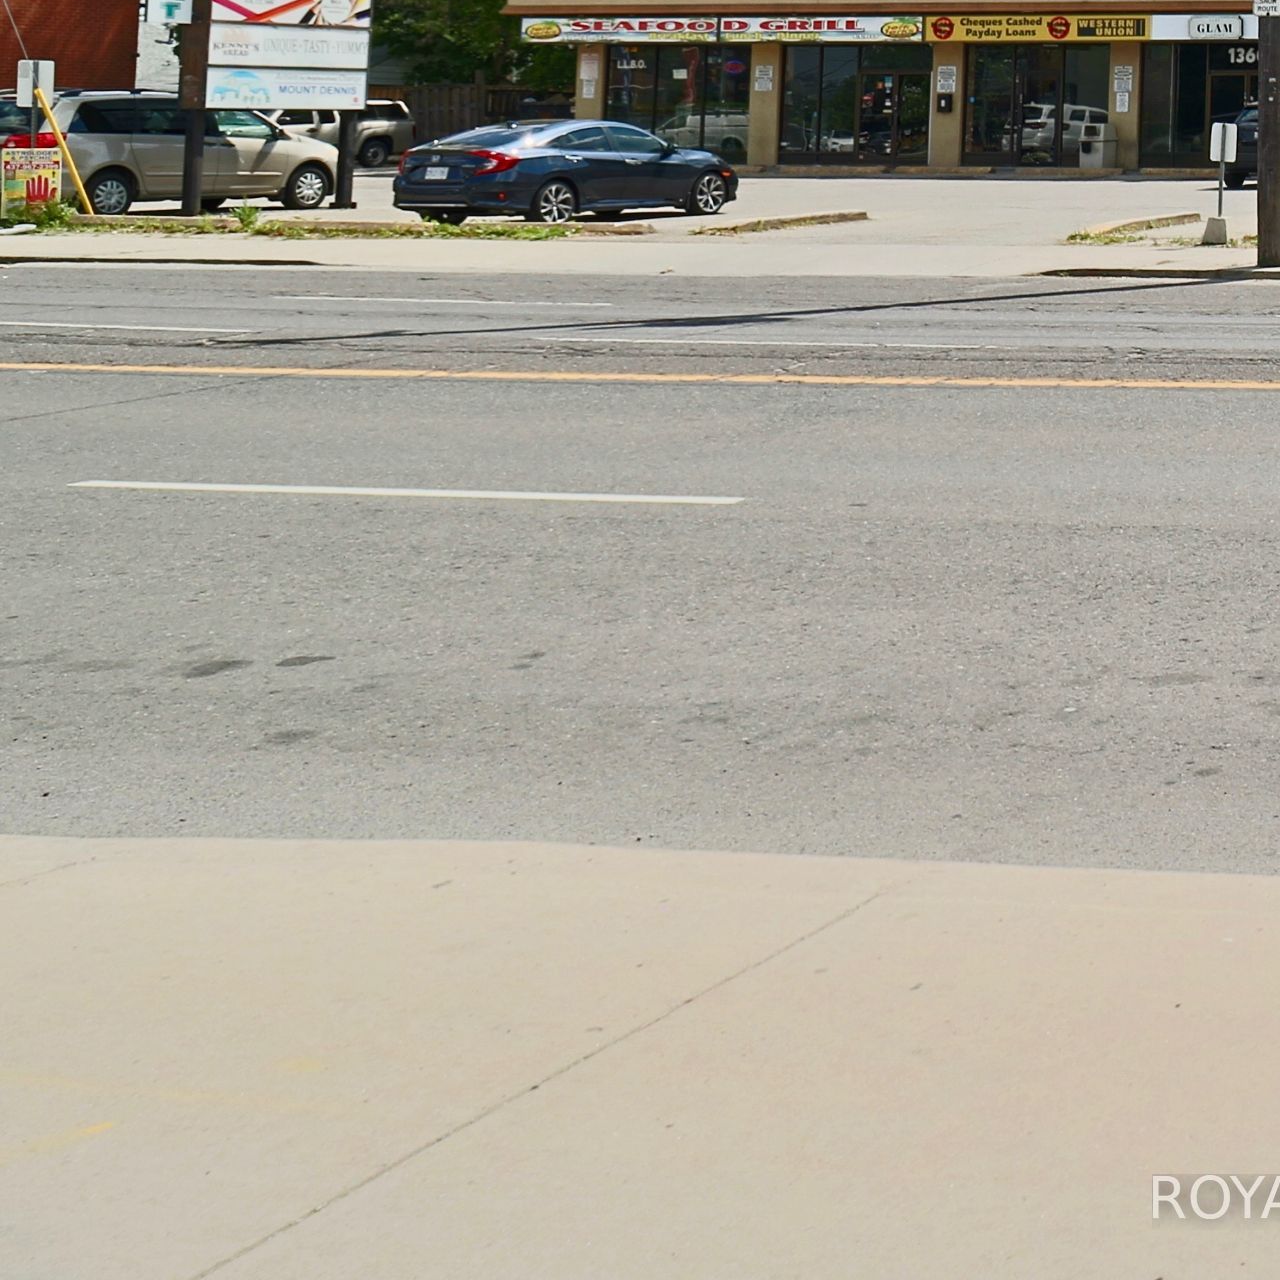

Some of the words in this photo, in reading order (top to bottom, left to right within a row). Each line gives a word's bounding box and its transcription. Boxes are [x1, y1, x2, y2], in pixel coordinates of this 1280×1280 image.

[571, 20, 749, 32] SEAFOOD
[759, 19, 865, 32] GRILL
[960, 18, 1003, 28] Cheques
[1006, 17, 1042, 26] Cashed
[1079, 19, 1134, 28] WESTERN
[1095, 28, 1134, 36] UNION
[1197, 23, 1232, 33] GLAM
[966, 29, 1002, 38] Payday
[263, 38, 297, 55] UNIQUE
[303, 39, 330, 55] TASTY
[1228, 48, 1259, 64] 136
[279, 85, 317, 95] MOUNT
[320, 86, 357, 95] DENNIS
